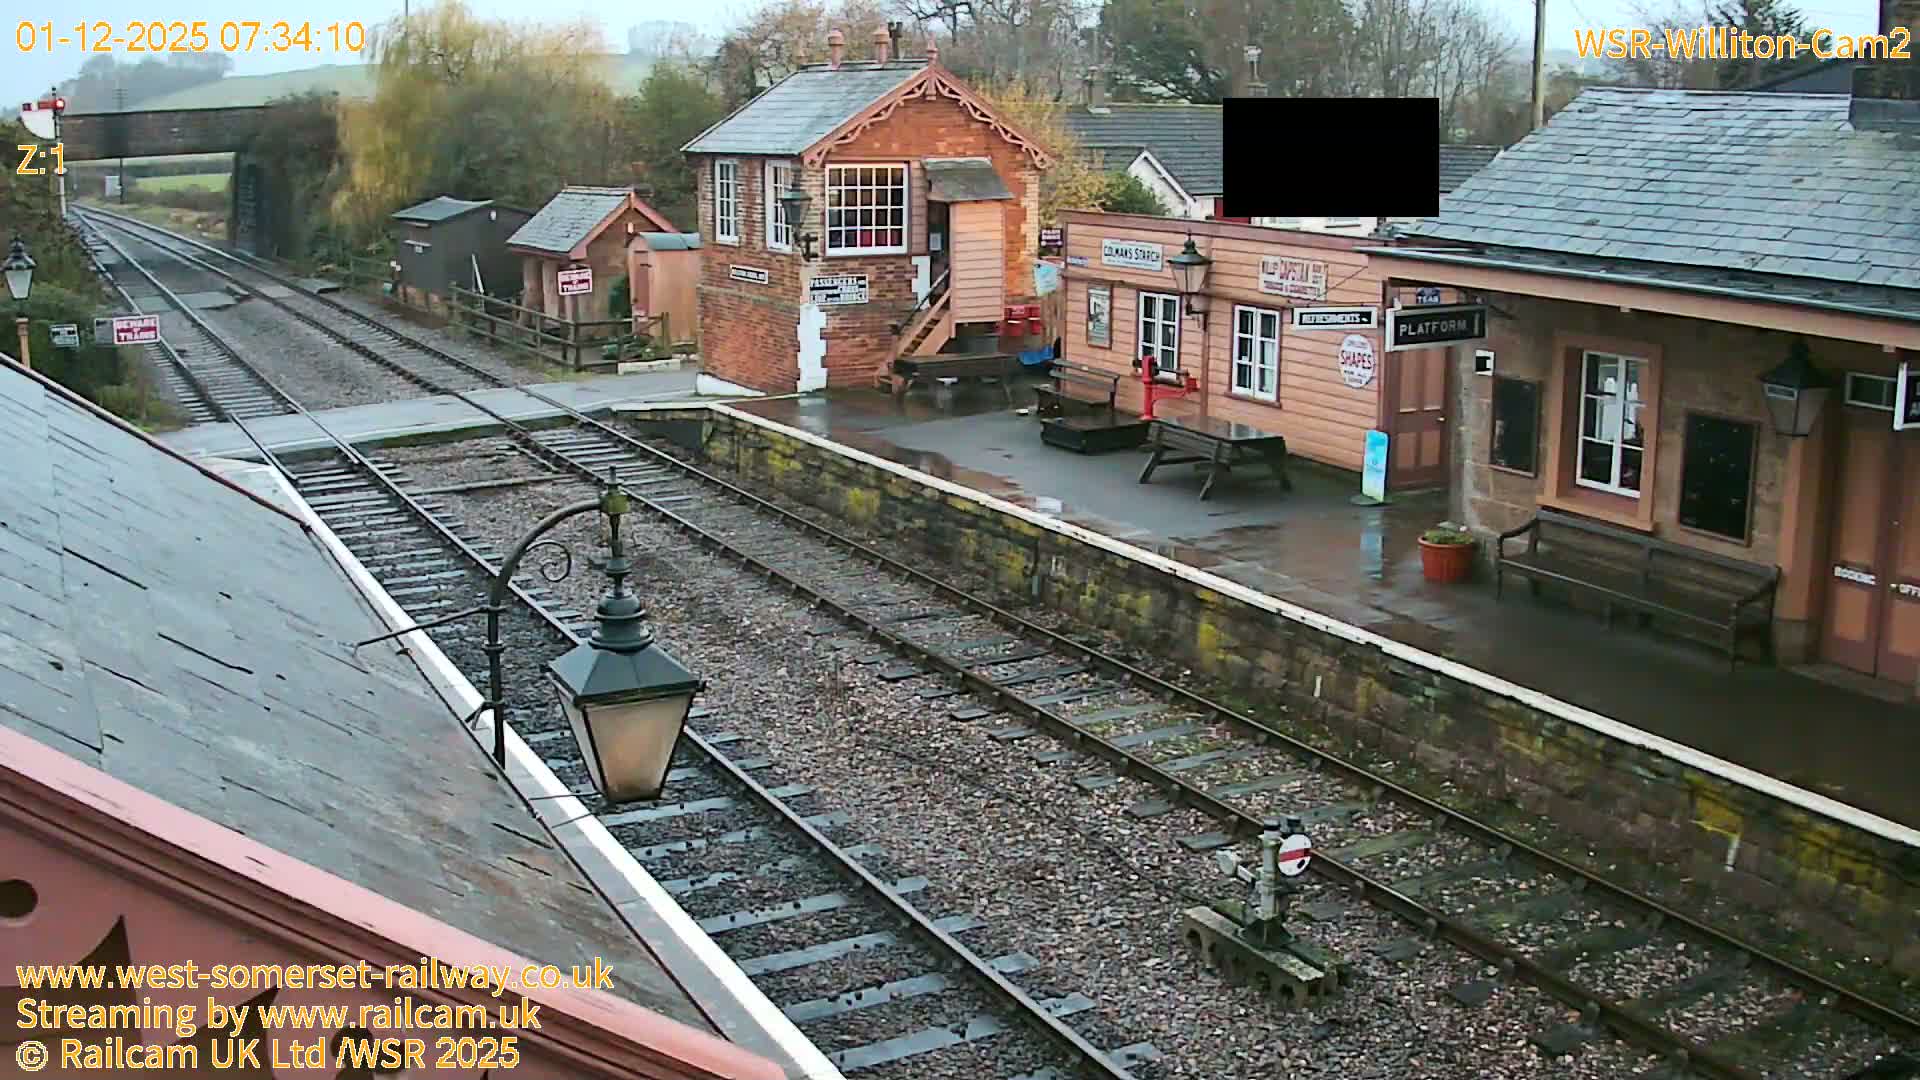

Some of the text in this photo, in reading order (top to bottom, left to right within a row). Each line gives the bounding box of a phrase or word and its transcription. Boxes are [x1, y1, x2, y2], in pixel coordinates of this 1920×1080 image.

[1135, 248, 1160, 262] STARCH
[1399, 319, 1467, 336] PLATFORM
[1341, 350, 1372, 370] SHAPES
